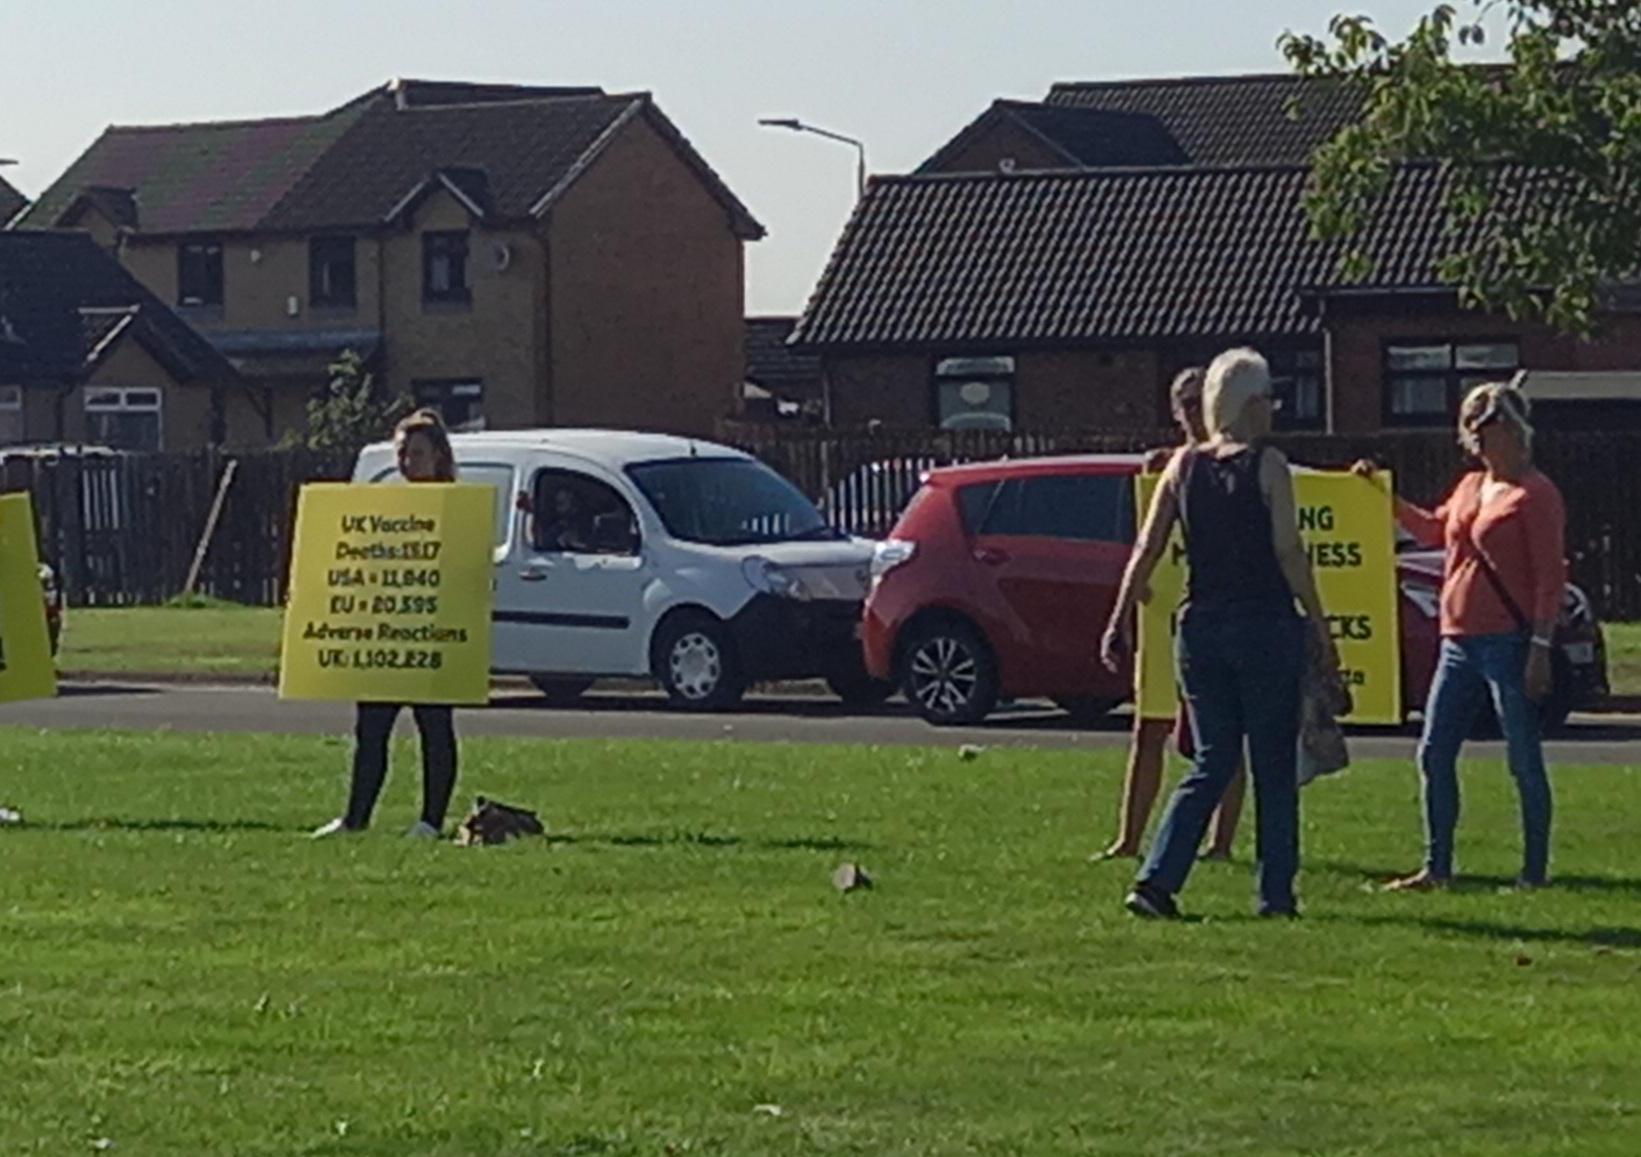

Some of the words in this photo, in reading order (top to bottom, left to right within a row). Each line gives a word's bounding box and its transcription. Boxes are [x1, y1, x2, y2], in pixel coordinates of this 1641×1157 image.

[342, 515, 366, 533] UK
[370, 514, 435, 533] Vaccine
[328, 569, 364, 586] USA
[330, 596, 354, 614] EU
[303, 622, 373, 640] Adverse
[377, 623, 467, 642] Reactions
